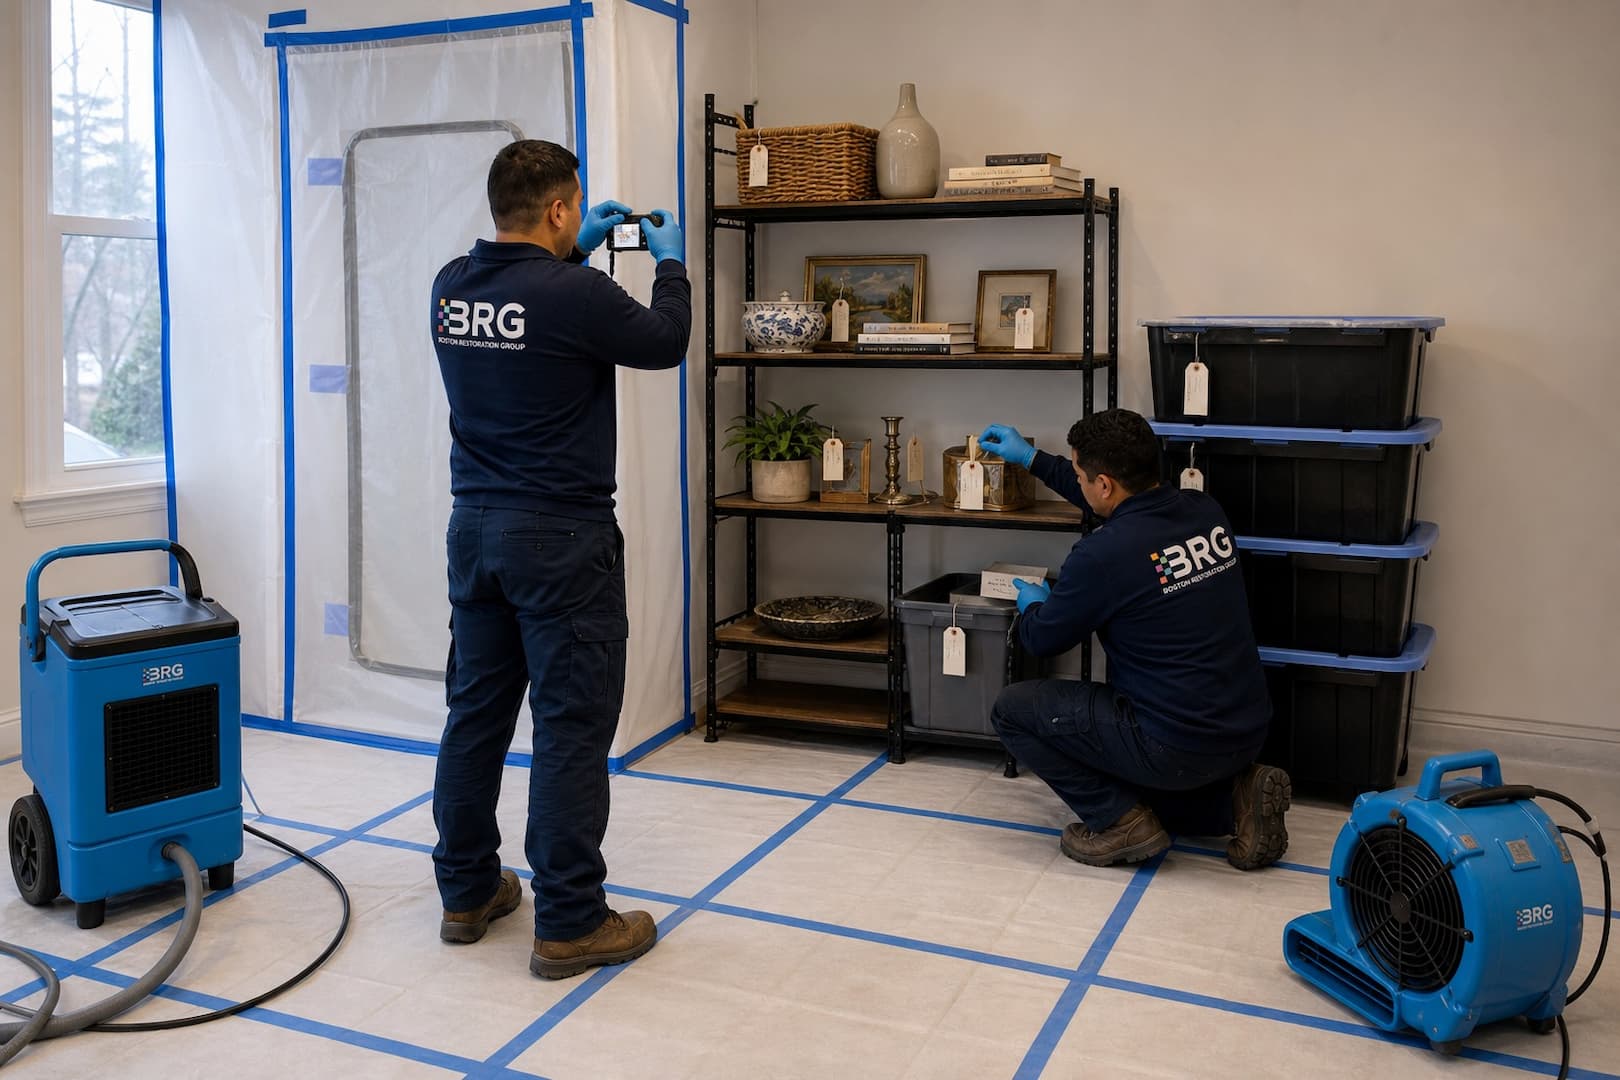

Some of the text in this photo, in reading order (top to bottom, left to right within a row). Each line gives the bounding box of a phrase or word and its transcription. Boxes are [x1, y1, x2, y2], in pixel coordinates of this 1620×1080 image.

[447, 299, 526, 340] BRG
[1162, 526, 1233, 580] BRG
[149, 663, 184, 681] BRG
[1522, 904, 1553, 925] BRG
